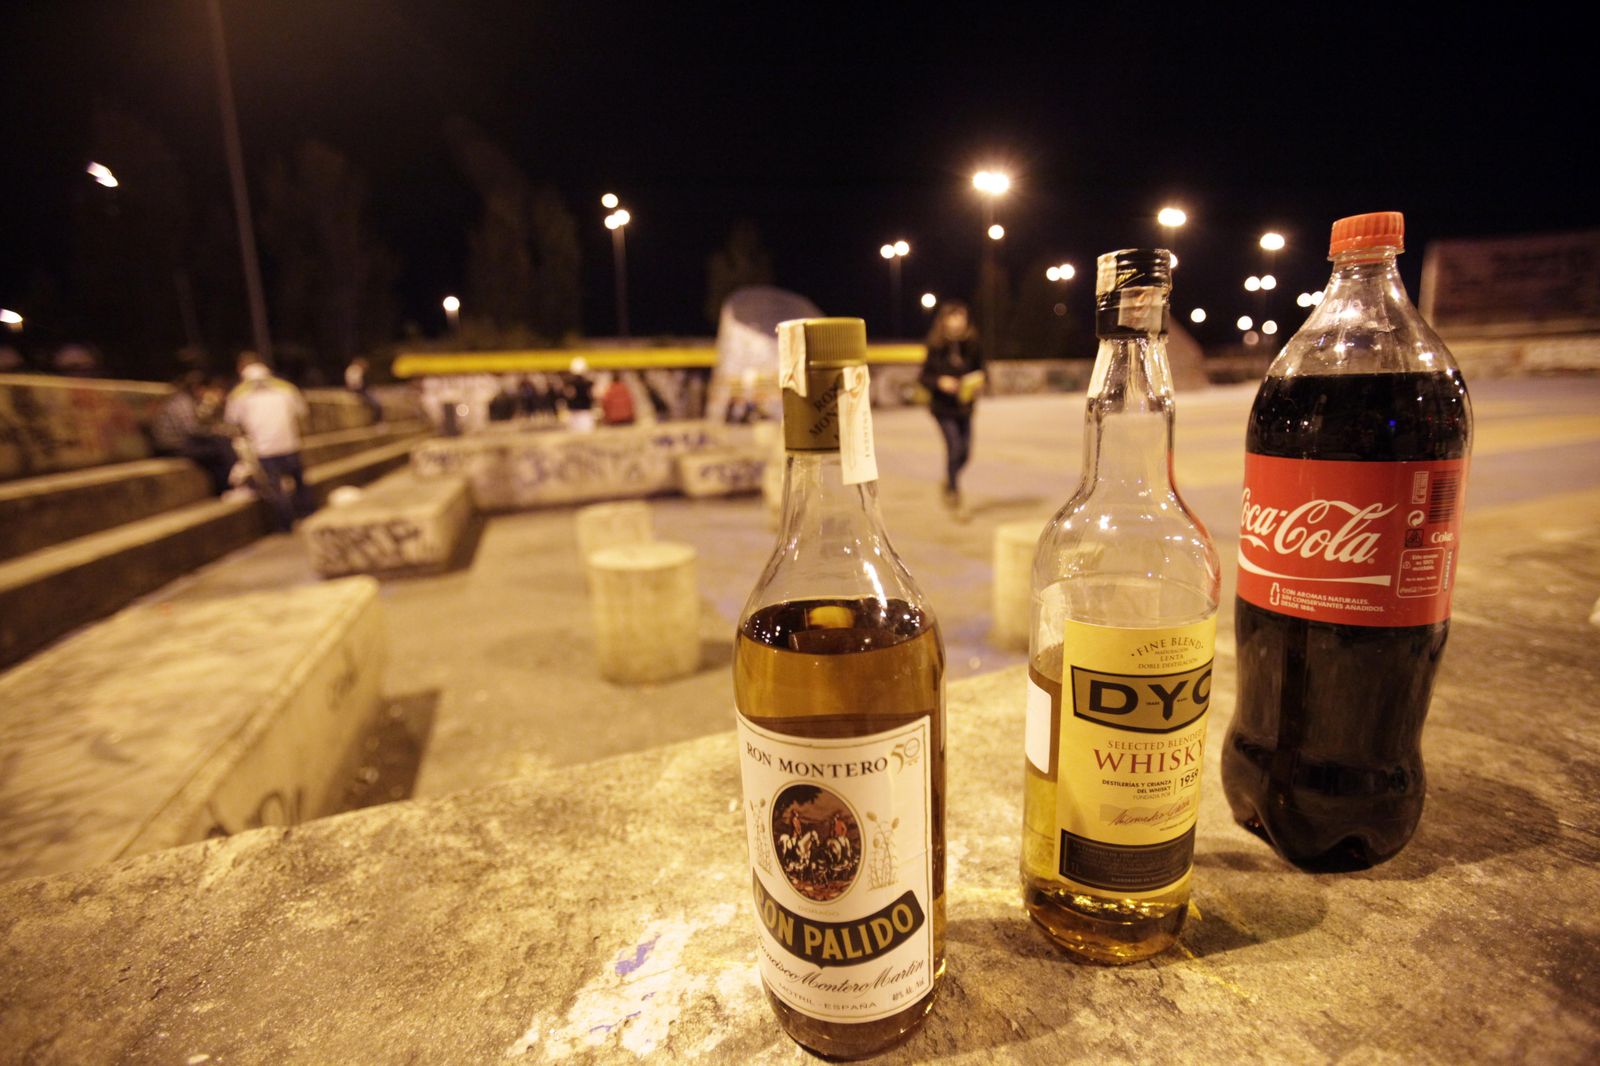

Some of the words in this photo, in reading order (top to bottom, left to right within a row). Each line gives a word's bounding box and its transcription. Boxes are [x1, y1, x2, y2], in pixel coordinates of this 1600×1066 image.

[809, 411, 838, 436] MON
[1282, 587, 1296, 595] CON
[1297, 591, 1327, 601] AROMAS
[1292, 596, 1343, 610] CONSERVANTES
[1093, 737, 1204, 774] WHISKY
[1107, 740, 1165, 751] SELECTED
[746, 741, 772, 768] RON
[779, 756, 888, 779] MONTERO
[1147, 779, 1172, 788] CRIANZA
[804, 903, 914, 961] PALIDO
[800, 971, 870, 994] Montero
